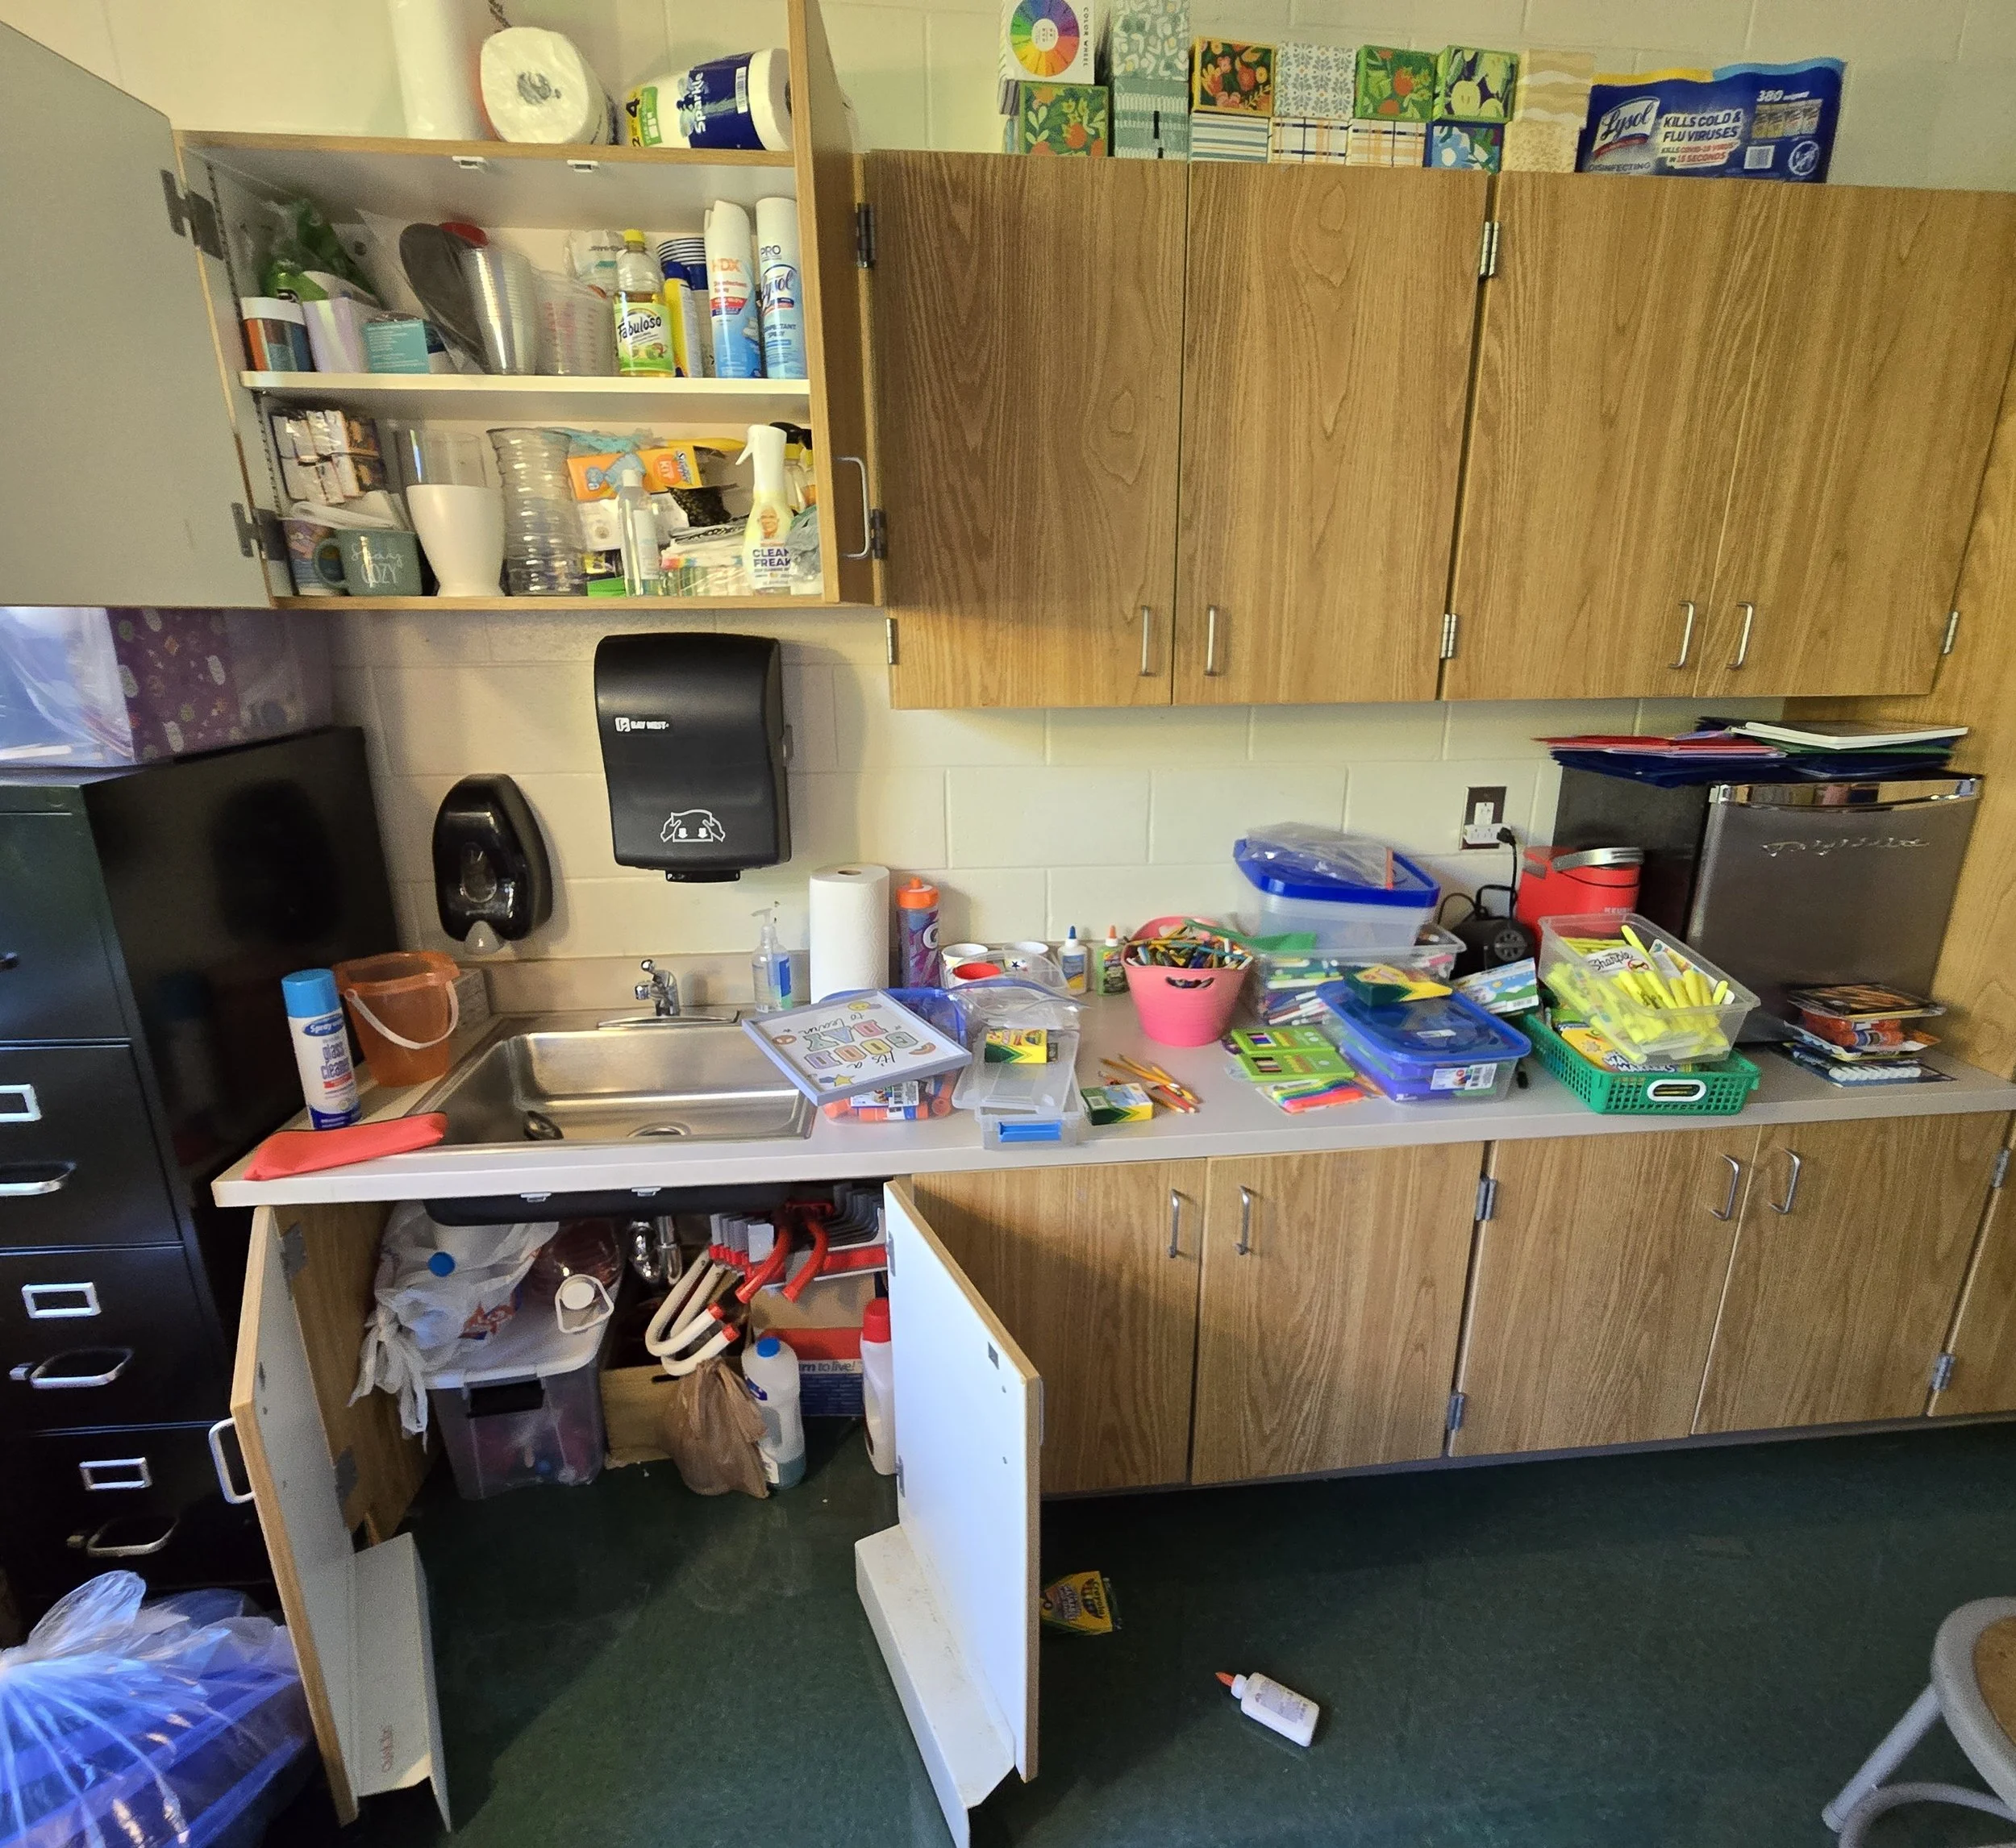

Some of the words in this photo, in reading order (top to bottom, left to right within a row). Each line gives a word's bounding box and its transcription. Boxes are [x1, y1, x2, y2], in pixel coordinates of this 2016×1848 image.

[626, 97, 640, 119] 4
[692, 72, 706, 134] Sparkle
[1600, 102, 1655, 141] Lysol
[1664, 116, 1697, 127] KILLS
[1697, 113, 1732, 127] COLD
[1663, 130, 1685, 142] FLU
[1687, 126, 1739, 141] VIRUSES
[1687, 152, 1727, 162] SECONDS
[760, 244, 781, 256] PRO
[617, 315, 662, 343] Fabuloso
[1589, 951, 1634, 972] Sharpie
[850, 1012, 865, 1021] to
[802, 1018, 889, 1052] DAY
[323, 1042, 344, 1063] glass
[804, 1030, 919, 1070] GOOD
